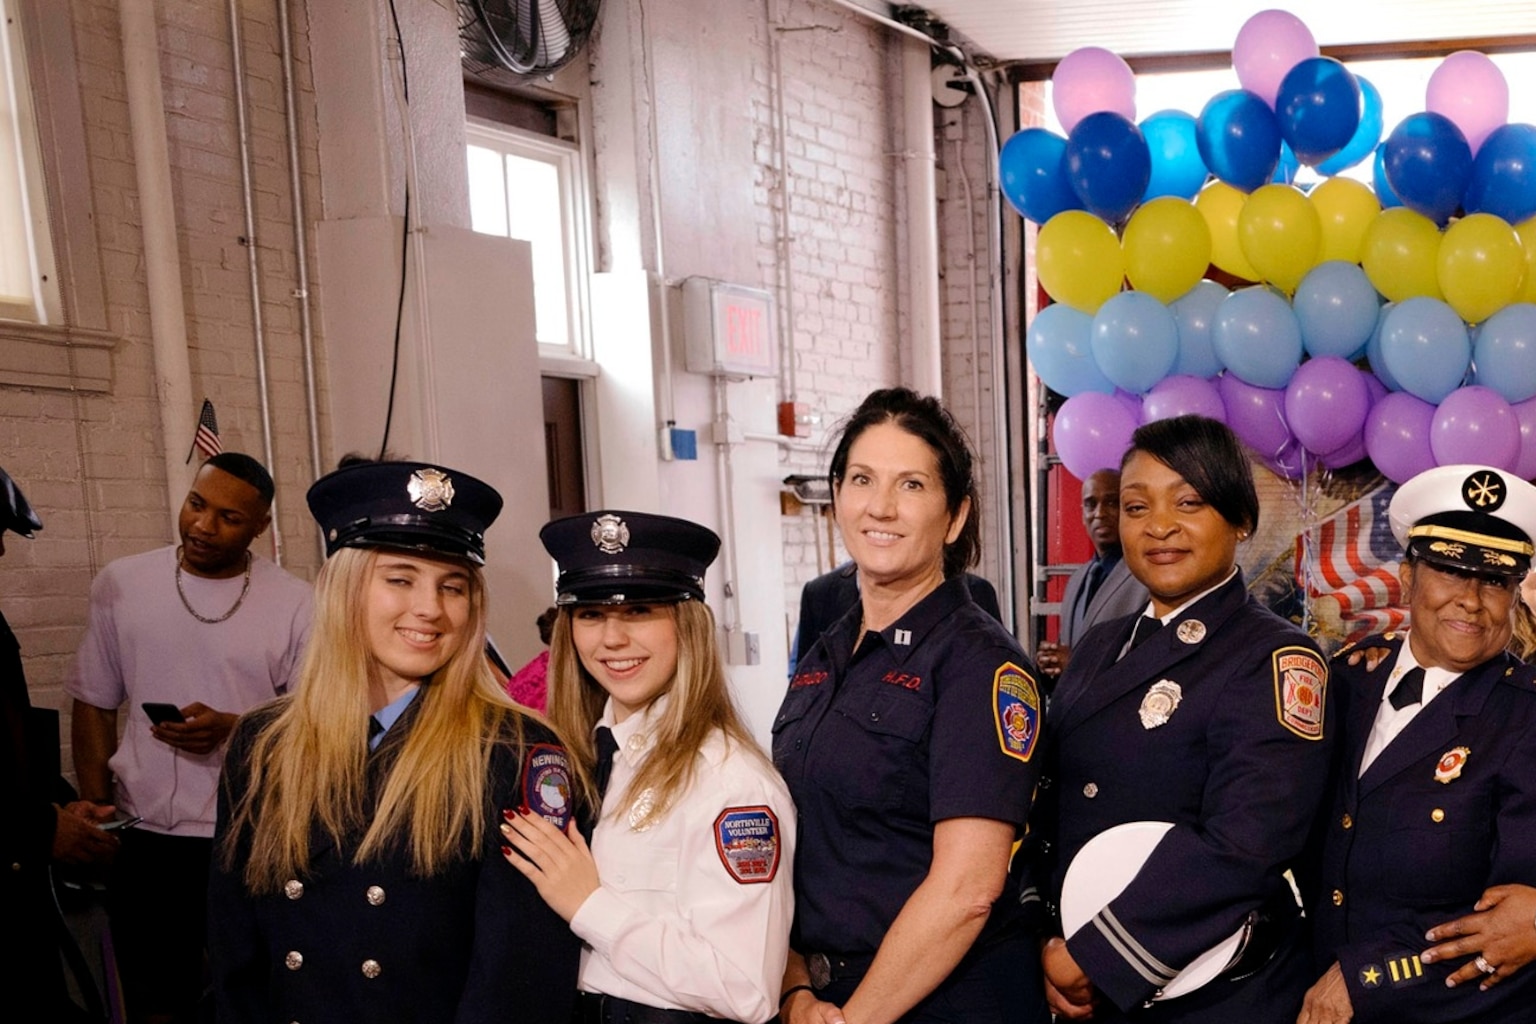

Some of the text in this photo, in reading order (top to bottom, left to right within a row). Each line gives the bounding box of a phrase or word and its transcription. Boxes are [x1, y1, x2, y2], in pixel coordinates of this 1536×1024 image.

[727, 304, 763, 355] EXIT
[882, 671, 921, 691] H.F.D.
[1300, 675, 1313, 686] FIRE
[1298, 706, 1313, 717] DEPT
[724, 818, 770, 829] NORTHVILLE
[728, 827, 768, 837] VOLUNTEER
